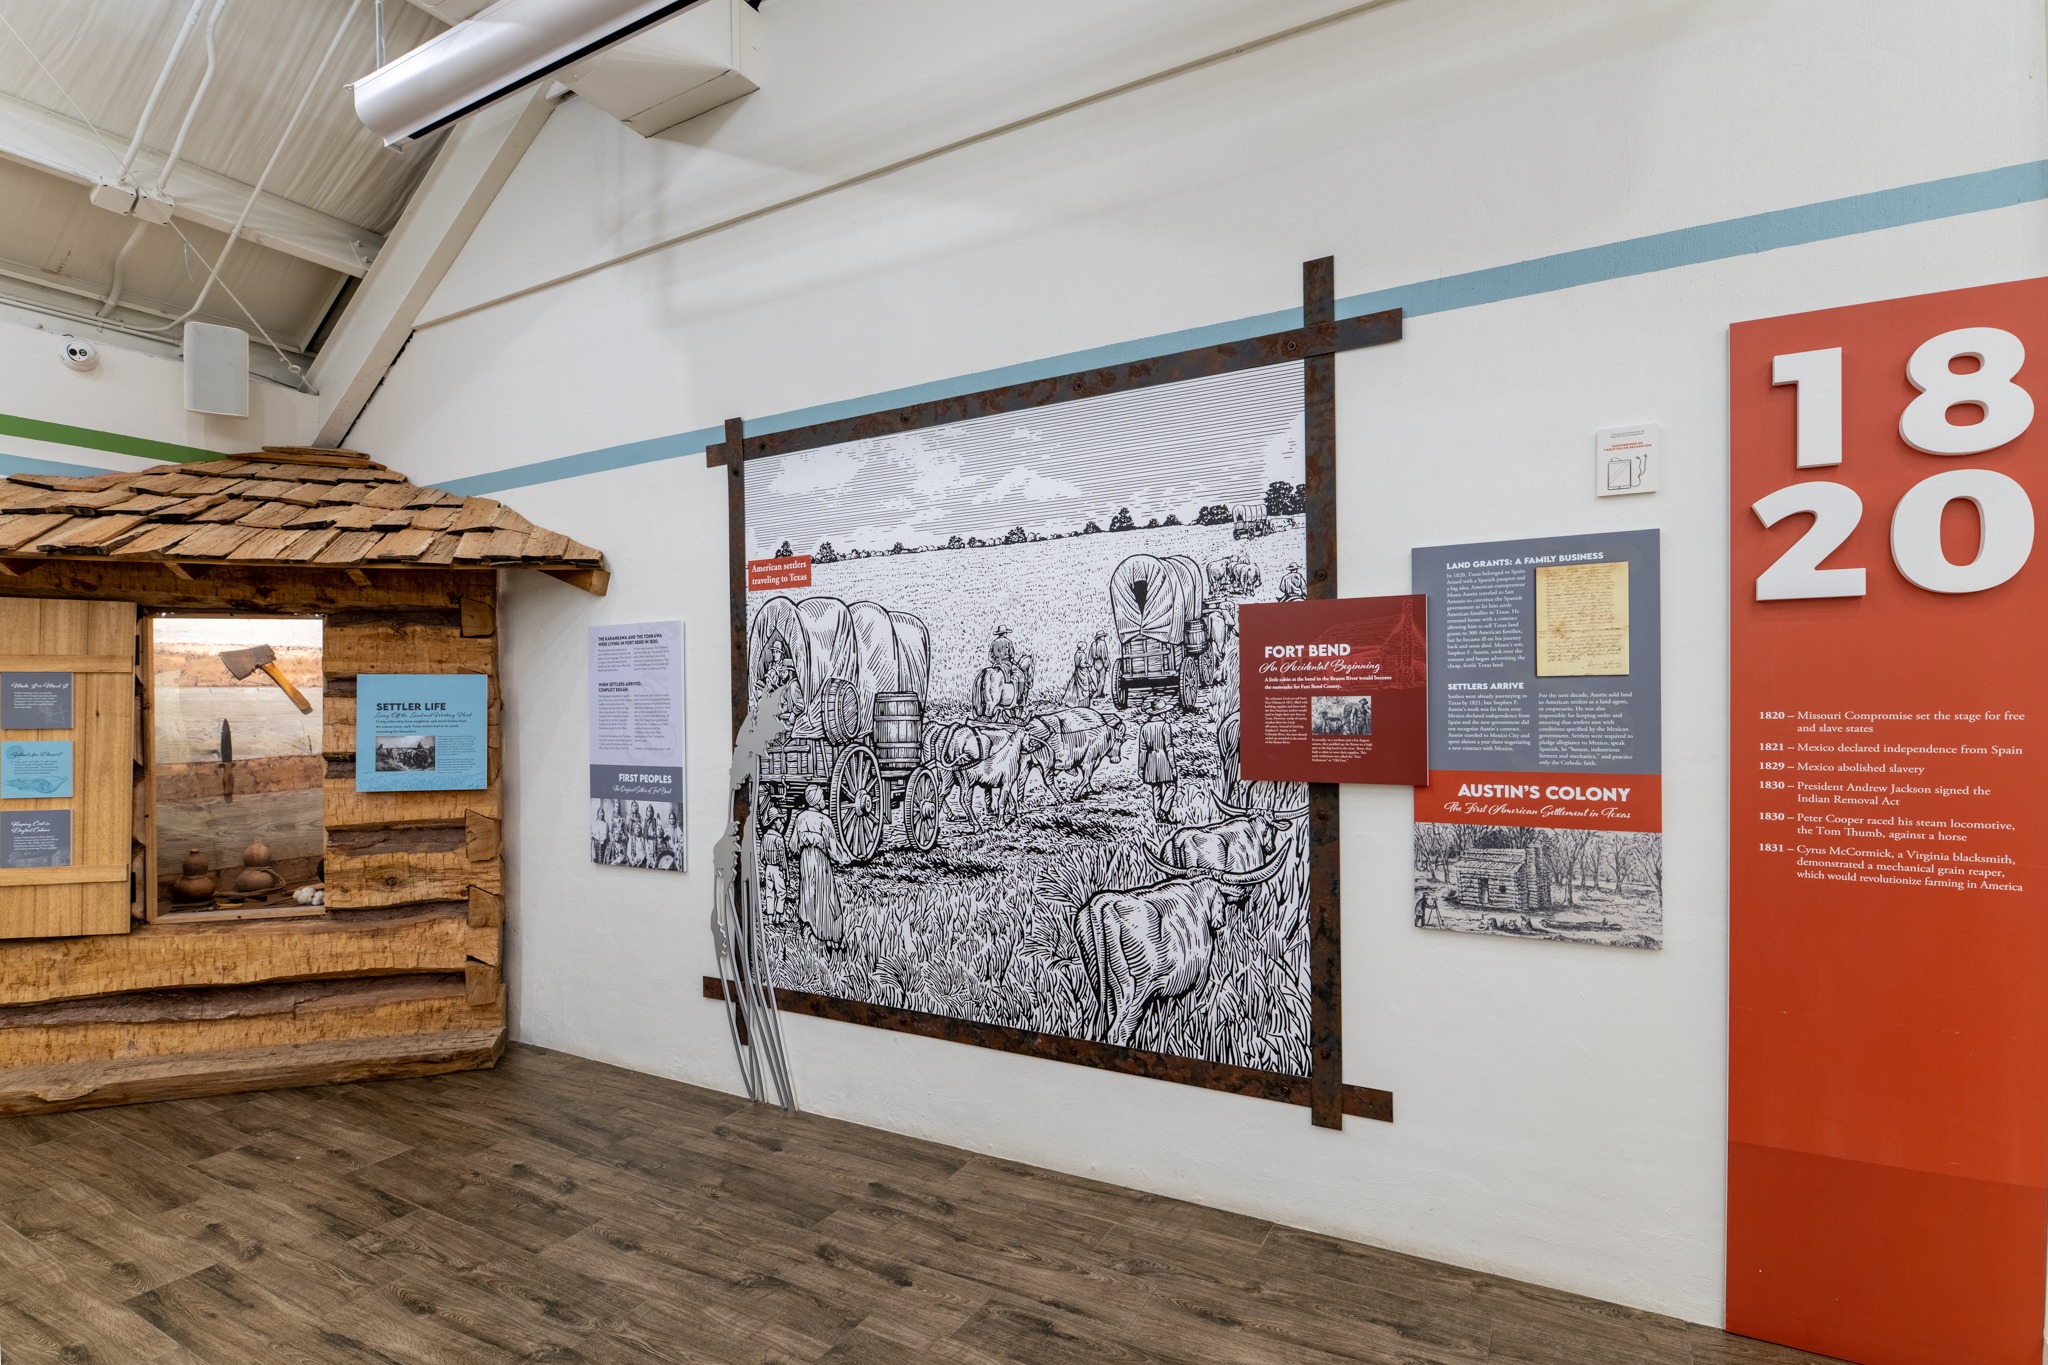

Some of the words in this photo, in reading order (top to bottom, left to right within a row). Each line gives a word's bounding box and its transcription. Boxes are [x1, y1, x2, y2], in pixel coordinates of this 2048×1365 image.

[752, 564, 782, 572] American
[784, 561, 806, 569] settlers
[1473, 559, 1512, 567] GRANTS:
[1524, 556, 1556, 564] FAMILY
[1559, 552, 1603, 561] BUSINESS
[752, 576, 780, 585] traveling
[1265, 645, 1304, 658] FORT
[1309, 644, 1350, 656] BEND
[1259, 661, 1277, 673] An
[1280, 661, 1330, 672] Accidental
[1330, 660, 1379, 674] Beginning
[1845, 711, 1912, 722] Compromise
[1934, 711, 1950, 720] the
[1954, 714, 1981, 722] stage
[1985, 711, 2001, 720] for
[2005, 711, 2025, 720] free
[1798, 724, 1816, 732] and
[1819, 724, 1842, 732] slave
[1798, 743, 1834, 751] Mexico
[1838, 743, 1880, 752] declared
[1884, 744, 1957, 755] independence
[1961, 745, 1987, 753] from
[1991, 745, 2022, 756] Spain
[1760, 762, 1784, 770] 1829
[1798, 762, 1834, 771] Mexico
[1838, 763, 1886, 772] abolished
[1889, 764, 1924, 775] slavery
[619, 774, 638, 782] FIRST
[640, 774, 672, 783] PEOPLES
[1458, 784, 1540, 799] AUSTIN'S
[1546, 786, 1630, 801] COLONY
[1760, 781, 1785, 789] 1830
[1798, 782, 1843, 791] President
[1847, 783, 1887, 792] Andrew
[1890, 784, 1931, 794] Jackson
[1935, 786, 1969, 796] signed
[1974, 786, 1990, 795] the
[1798, 794, 1830, 803] Indian
[1834, 795, 1878, 804] Removal
[1882, 797, 1899, 805] Act
[1444, 802, 1461, 812] The
[1464, 803, 1487, 813] First
[1487, 804, 1537, 814] American
[1540, 805, 1589, 816] Settlement
[1601, 808, 1630, 818] Texas
[1760, 812, 1784, 820] 1830
[1798, 813, 1822, 822] Peter
[1826, 815, 1864, 826] Cooper
[1868, 817, 1894, 825] raced
[1898, 817, 1912, 825] his
[1951, 819, 2015, 831] locomotive,
[1798, 826, 1813, 834] the
[1816, 826, 1840, 835] Tom
[1844, 828, 1885, 838] Thumb,
[1889, 831, 1925, 840] against
[1938, 832, 1967, 841] horse
[1760, 844, 1783, 852] 1831
[1797, 845, 1826, 855] Cyrus
[1830, 847, 1894, 858] McCormick,
[1907, 850, 1949, 862] Virginia
[1953, 852, 2015, 865] blacksmith,
[1797, 857, 1864, 869] demonstrated
[1877, 862, 1934, 872] mechanical
[1938, 866, 1964, 875] grain
[1797, 870, 1824, 879] which
[1828, 872, 1856, 881] would
[1860, 874, 1922, 885] revolutionize
[1925, 877, 1964, 889] farming
[1980, 881, 2023, 891] America
